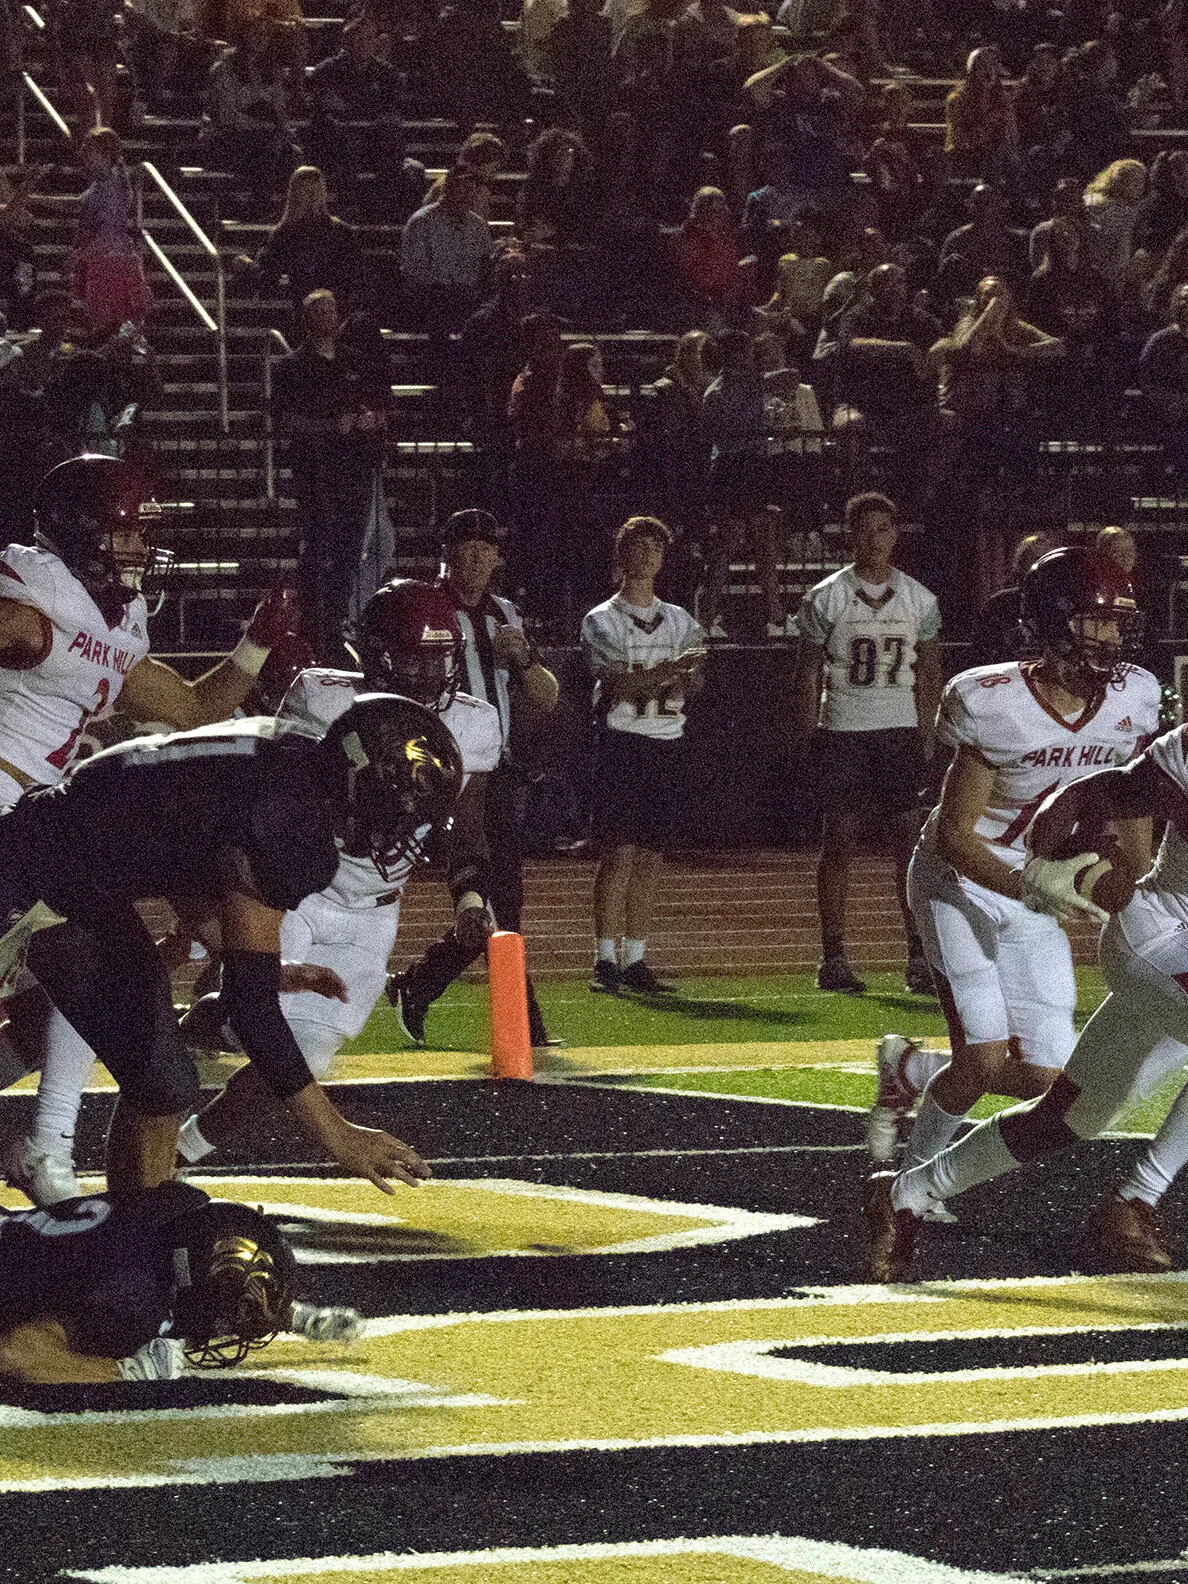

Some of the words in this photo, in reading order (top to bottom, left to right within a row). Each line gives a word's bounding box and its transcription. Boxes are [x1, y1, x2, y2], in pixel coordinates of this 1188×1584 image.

[69, 631, 112, 668] PARK
[849, 635, 906, 687] 87
[1021, 747, 1074, 768] PARK
[1077, 745, 1116, 767] HILL
